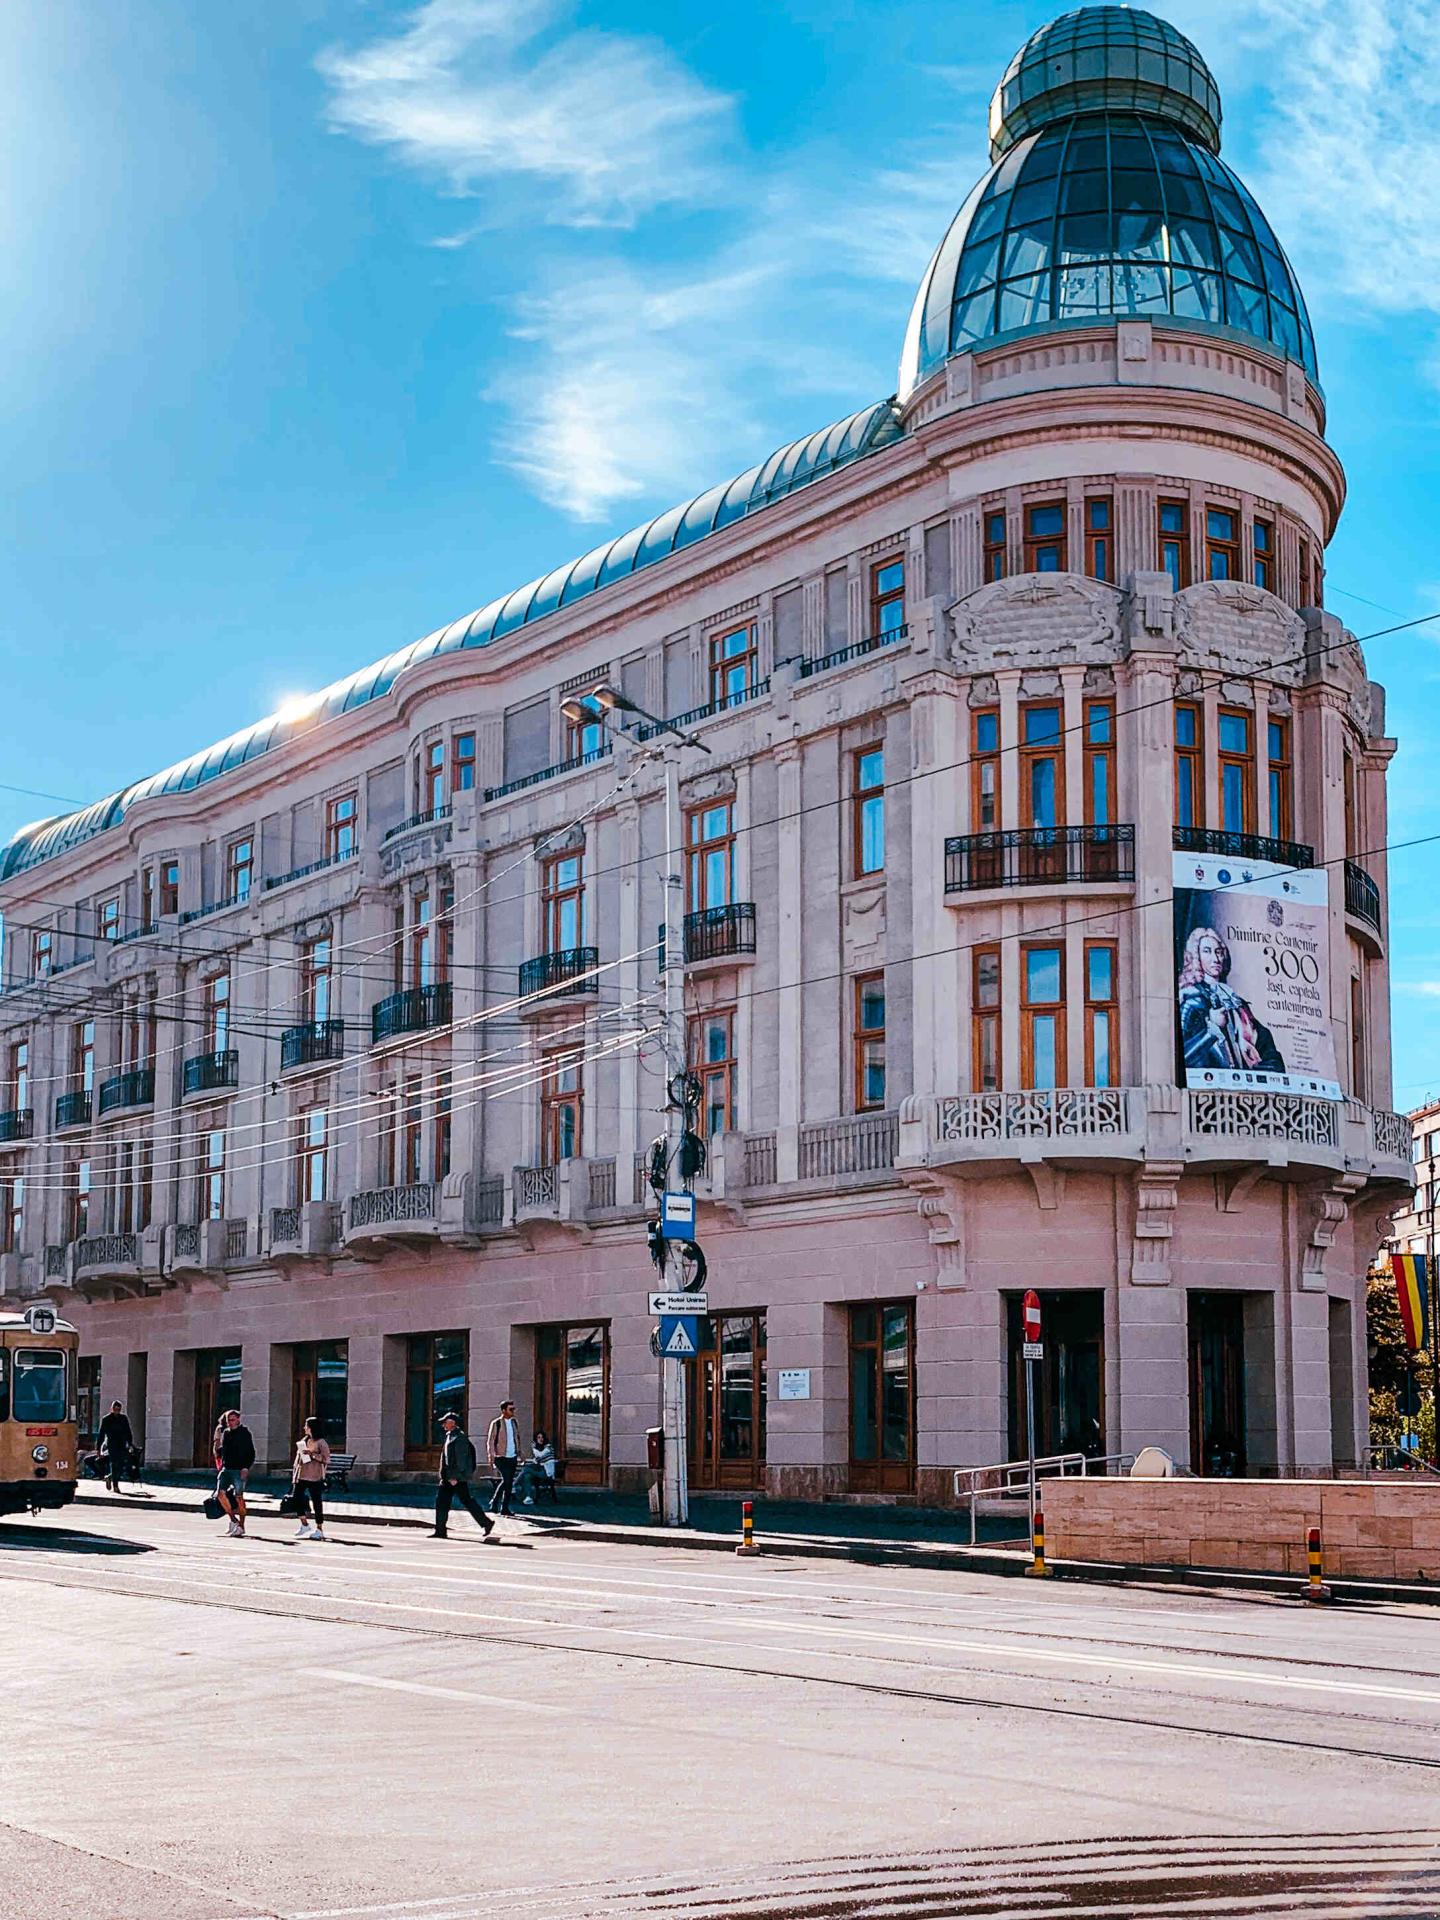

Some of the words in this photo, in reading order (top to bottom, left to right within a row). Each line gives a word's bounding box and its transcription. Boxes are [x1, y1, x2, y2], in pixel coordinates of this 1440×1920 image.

[1227, 925, 1272, 944] Dimitrie
[1275, 932, 1318, 953] Cantemir
[1263, 946, 1319, 984] 300
[40, 1319, 45, 1330] 1
